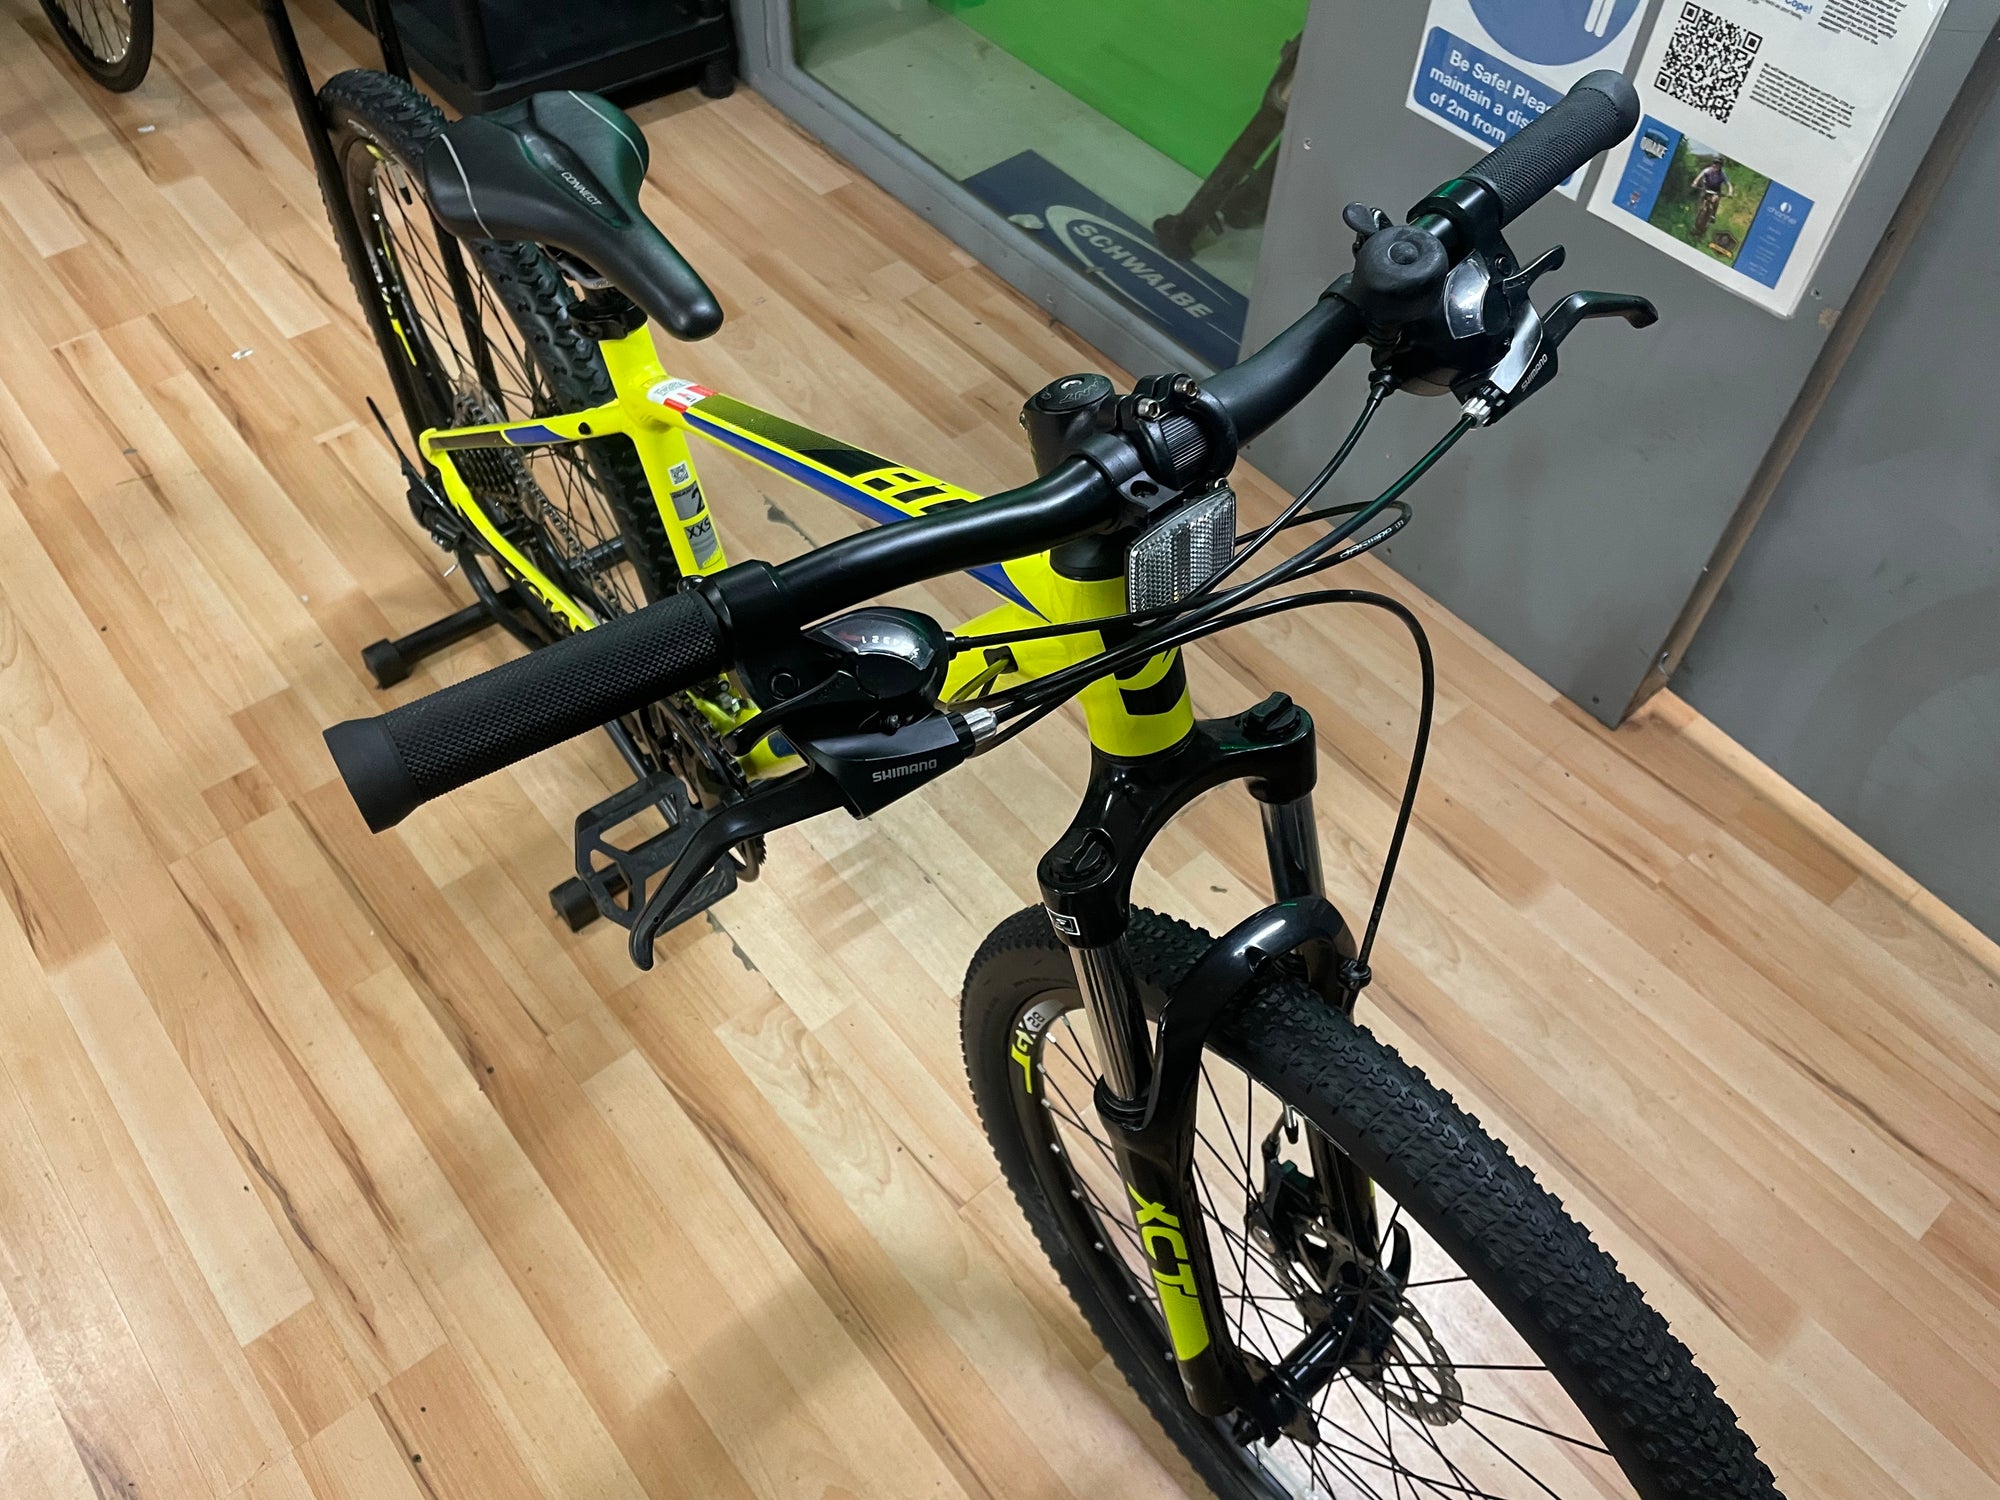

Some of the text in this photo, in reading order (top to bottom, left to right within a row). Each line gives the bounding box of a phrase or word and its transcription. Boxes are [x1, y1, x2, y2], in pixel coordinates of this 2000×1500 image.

[1429, 67, 1491, 110] maintain
[1494, 104, 1503, 117] a
[1449, 49, 1469, 72] Be
[1472, 62, 1511, 94] Safe!
[1429, 92, 1507, 143] of 2m from
[561, 171, 602, 205] CONNECT
[1073, 223, 1214, 319] SCHWALBE
[1521, 354, 1548, 392] SHIMANO
[872, 758, 937, 783] SHIMANO
[1027, 1012, 1045, 1028] 28
[1127, 1181, 1199, 1302] XCT
